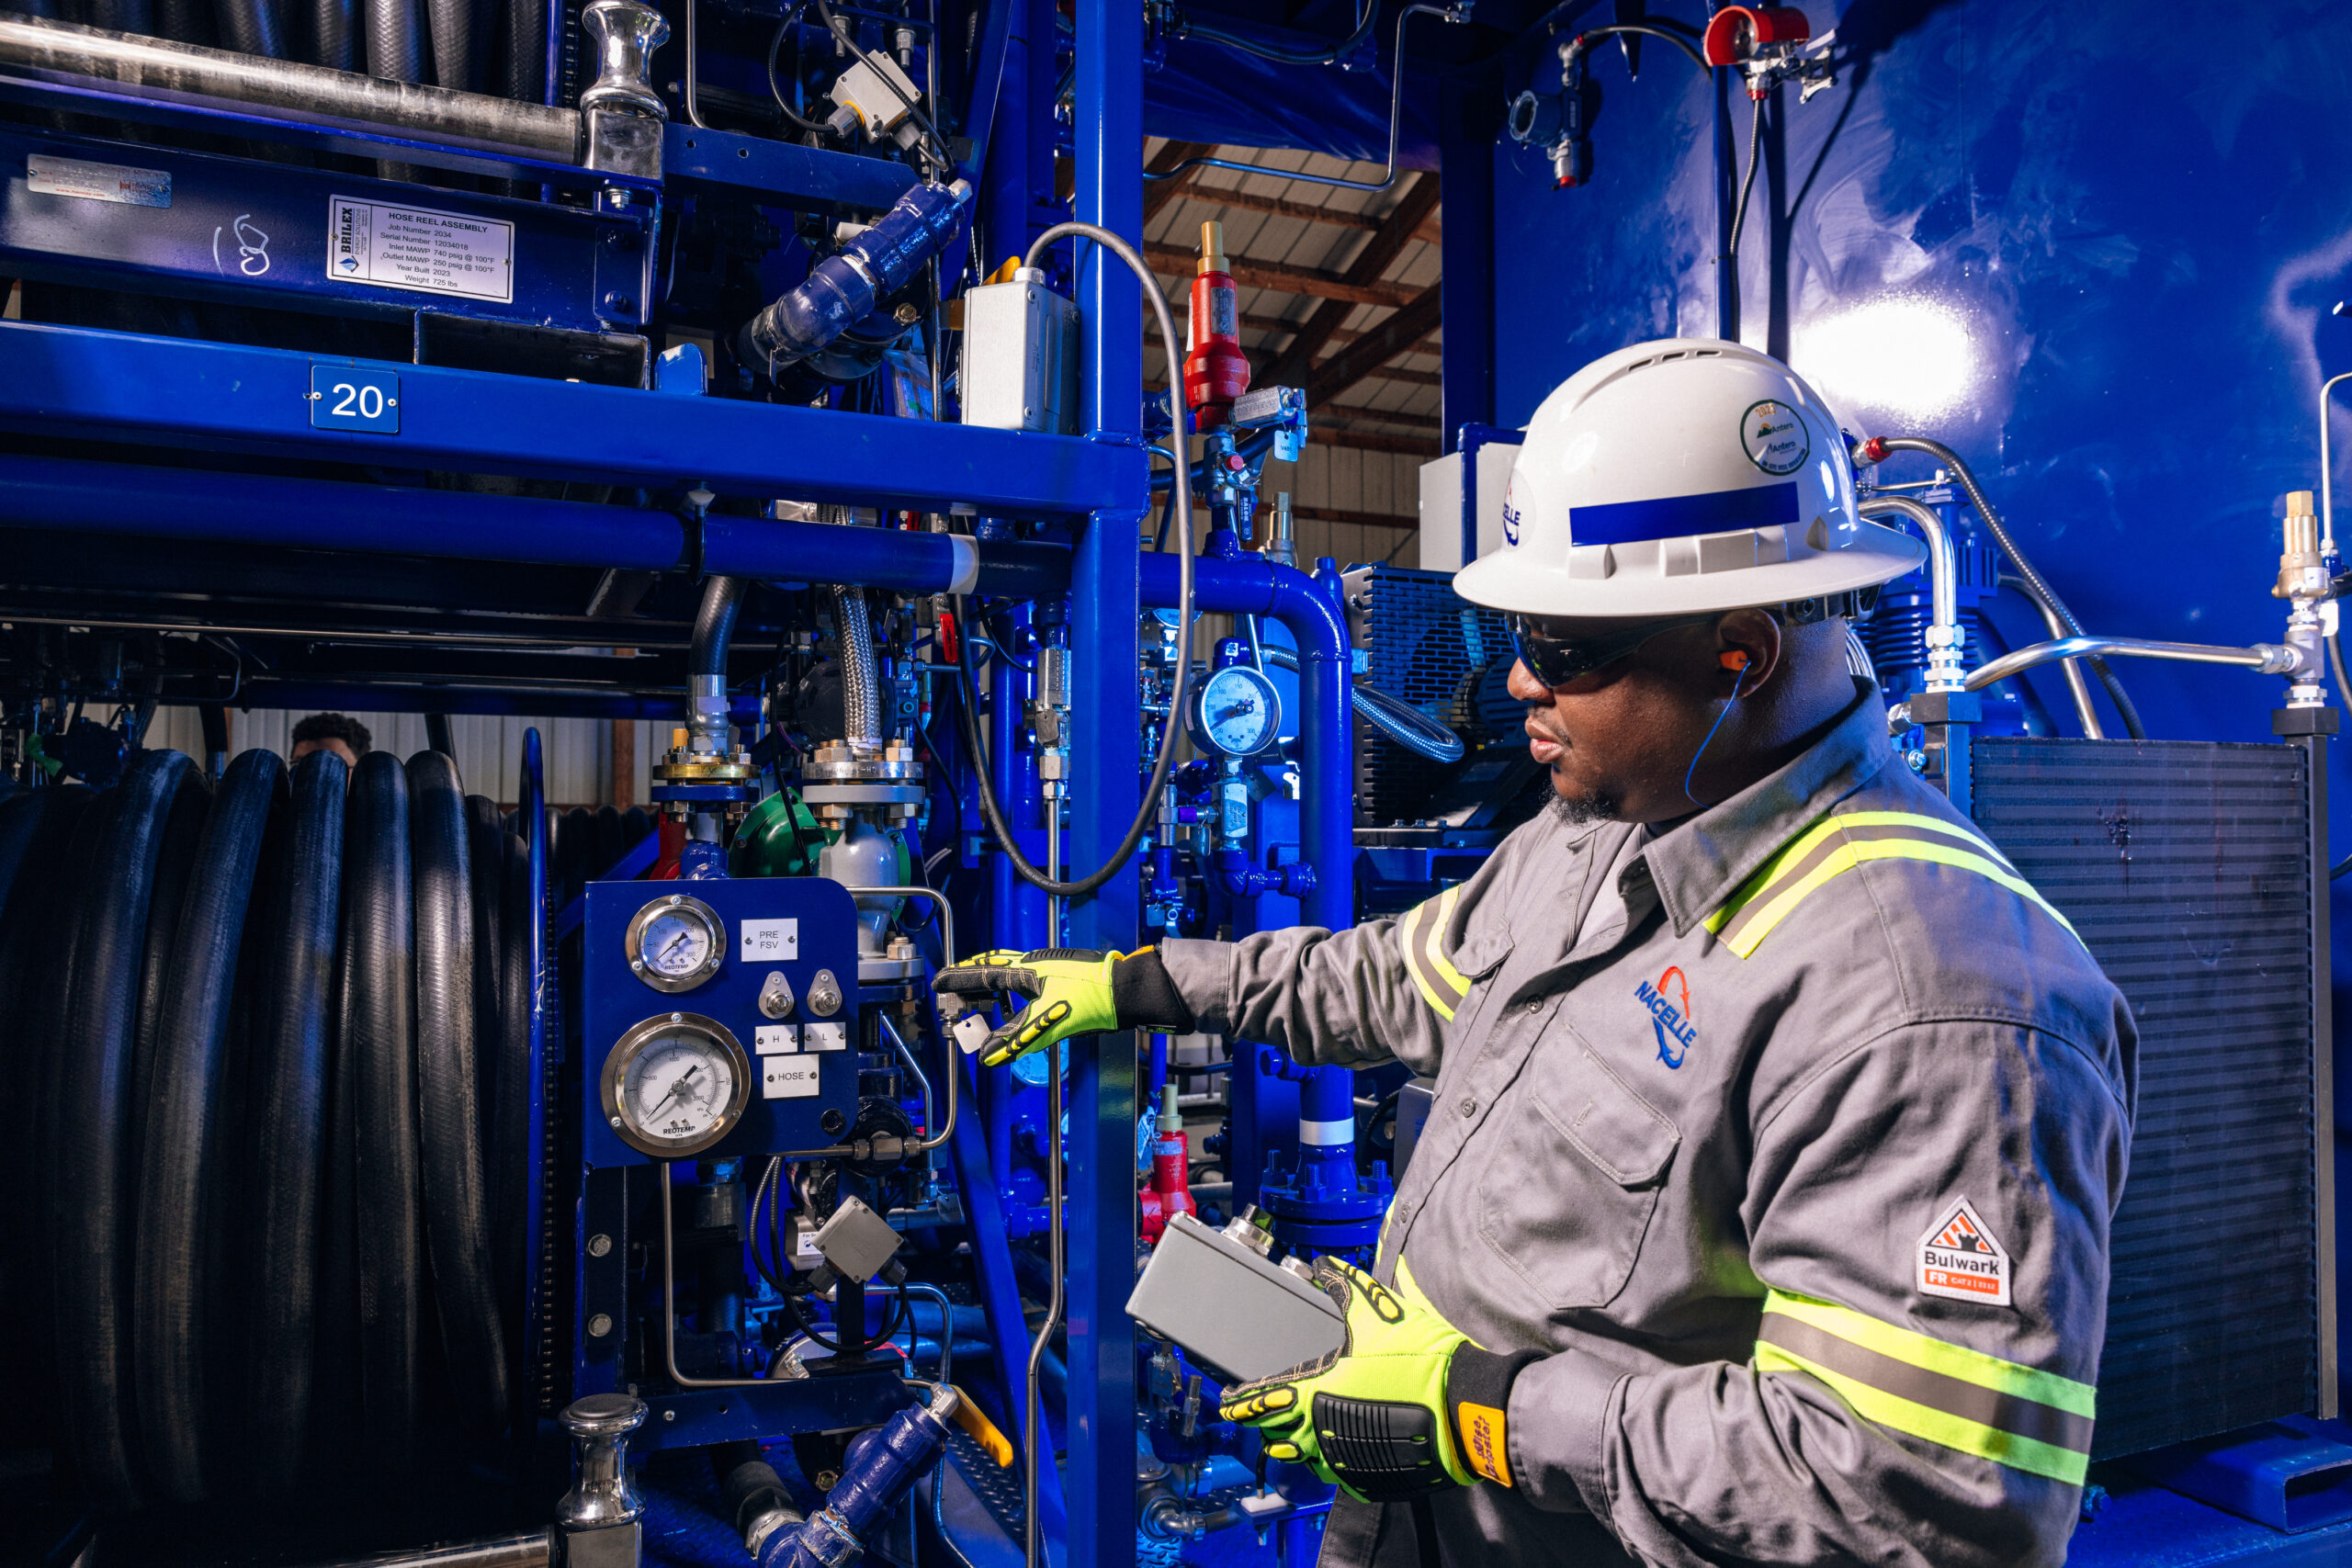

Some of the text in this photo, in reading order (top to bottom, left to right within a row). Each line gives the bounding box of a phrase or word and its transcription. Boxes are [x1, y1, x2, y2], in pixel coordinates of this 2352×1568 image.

[389, 212, 488, 233] HOSE REEL ASSEMBLY
[341, 207, 353, 254] BRILEX
[402, 224, 431, 235] Number
[434, 230, 452, 238] 2034
[379, 231, 469, 251] Serial Number 12034018
[406, 245, 430, 254] MAWP
[448, 252, 463, 261] psig
[464, 254, 473, 262] @
[475, 254, 495, 264] 100°F
[382, 253, 495, 274] Outlet MAWP 250 psig @ 100°F
[396, 264, 451, 276] Year Built 2023
[404, 274, 430, 284] Weight
[331, 382, 384, 419] 20
[1771, 423, 1794, 434] Antero
[1773, 441, 1796, 453] Antero
[759, 931, 779, 939] PRE
[1634, 980, 1697, 1048] NACELLE
[822, 1032, 827, 1041] L
[778, 1072, 805, 1081] HOSE
[662, 1125, 695, 1134] REOTEMP
[1924, 1251, 1999, 1275] Bulwark
[1928, 1271, 1949, 1285] FR
[1951, 1277, 1966, 1285] CAT
